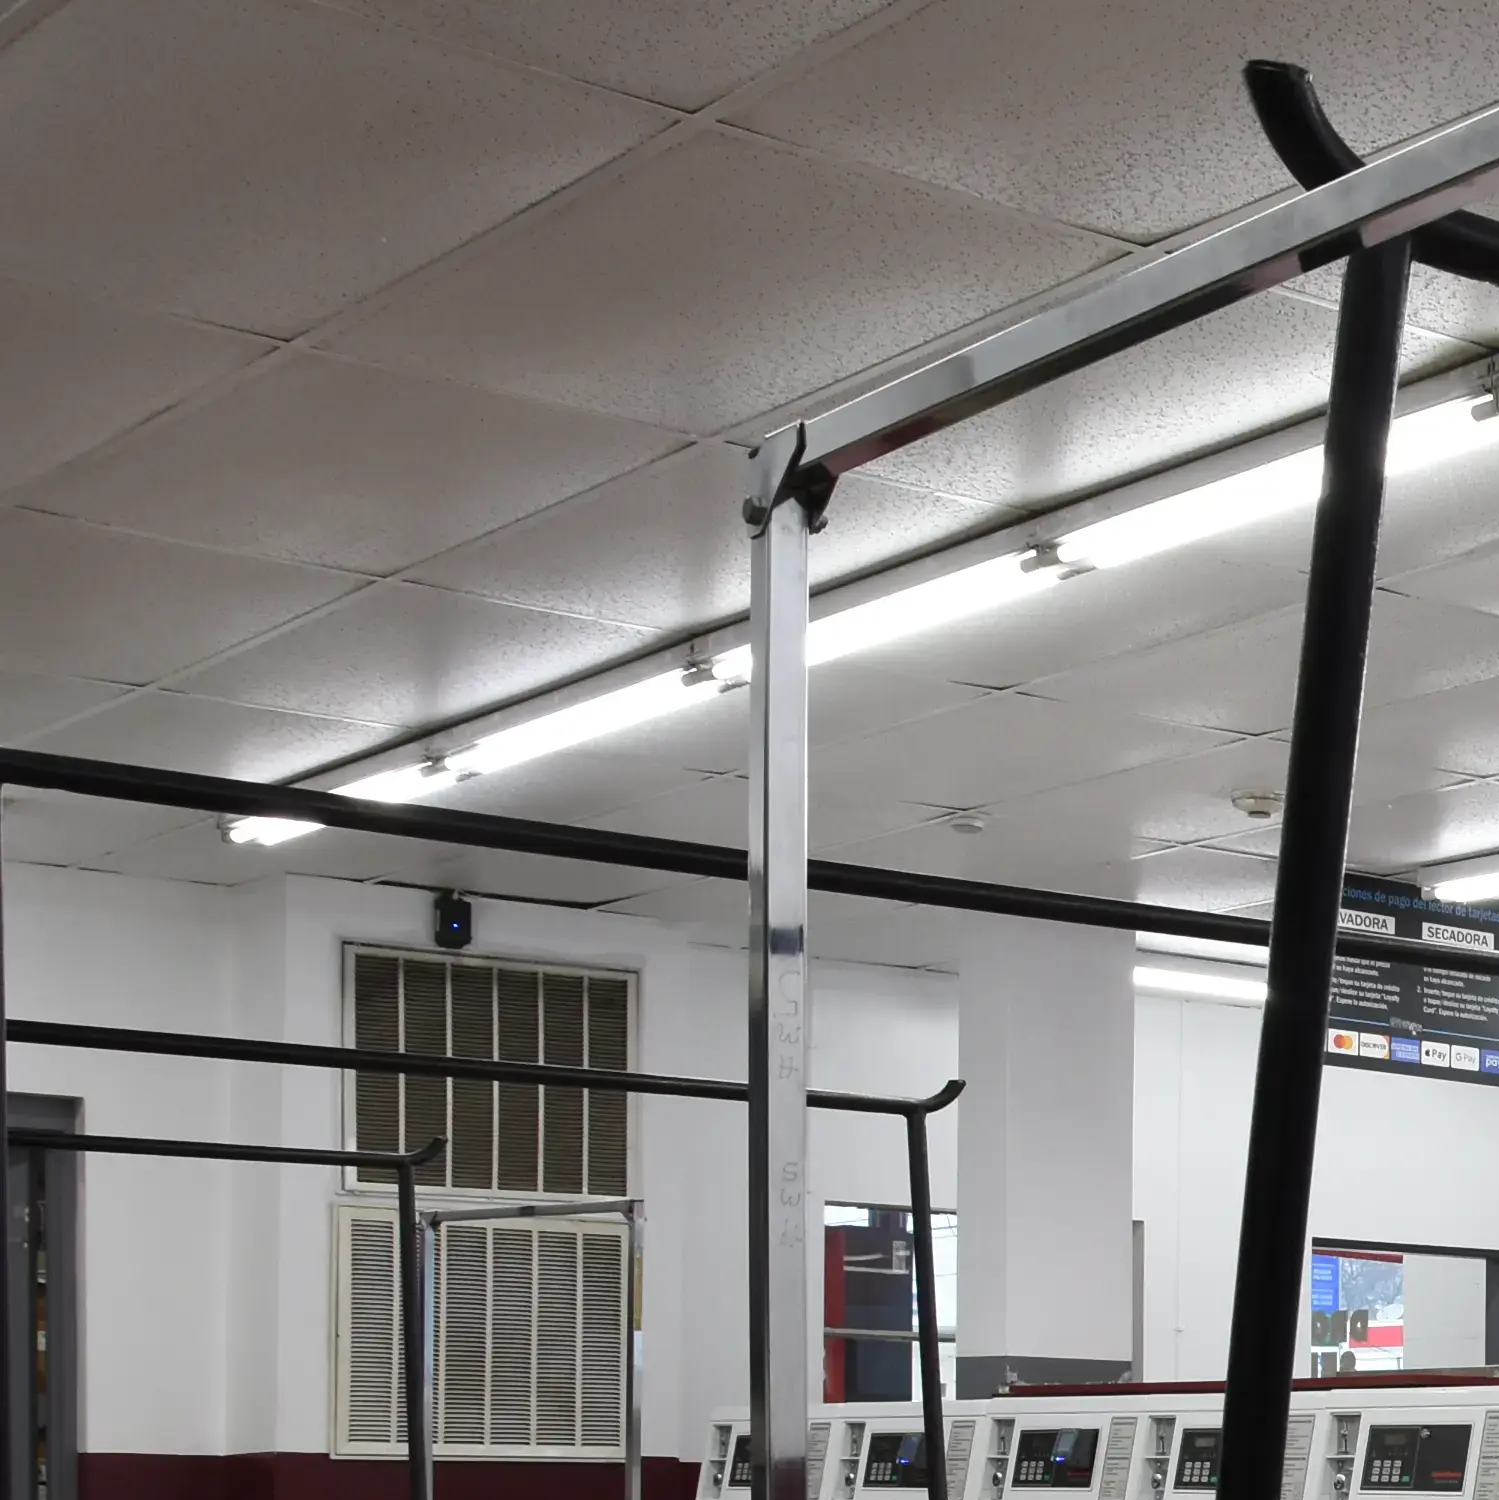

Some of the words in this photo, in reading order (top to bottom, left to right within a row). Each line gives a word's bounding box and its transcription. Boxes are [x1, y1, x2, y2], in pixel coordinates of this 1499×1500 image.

[1342, 886, 1372, 900] ciones
[1374, 890, 1386, 903] de
[1388, 895, 1411, 908] pago
[1455, 904, 1467, 916] de
[1338, 911, 1388, 931] VADORA
[1427, 926, 1489, 947] SECADORA
[1432, 1049, 1447, 1062] Pay
[1463, 1054, 1476, 1065] Pay
